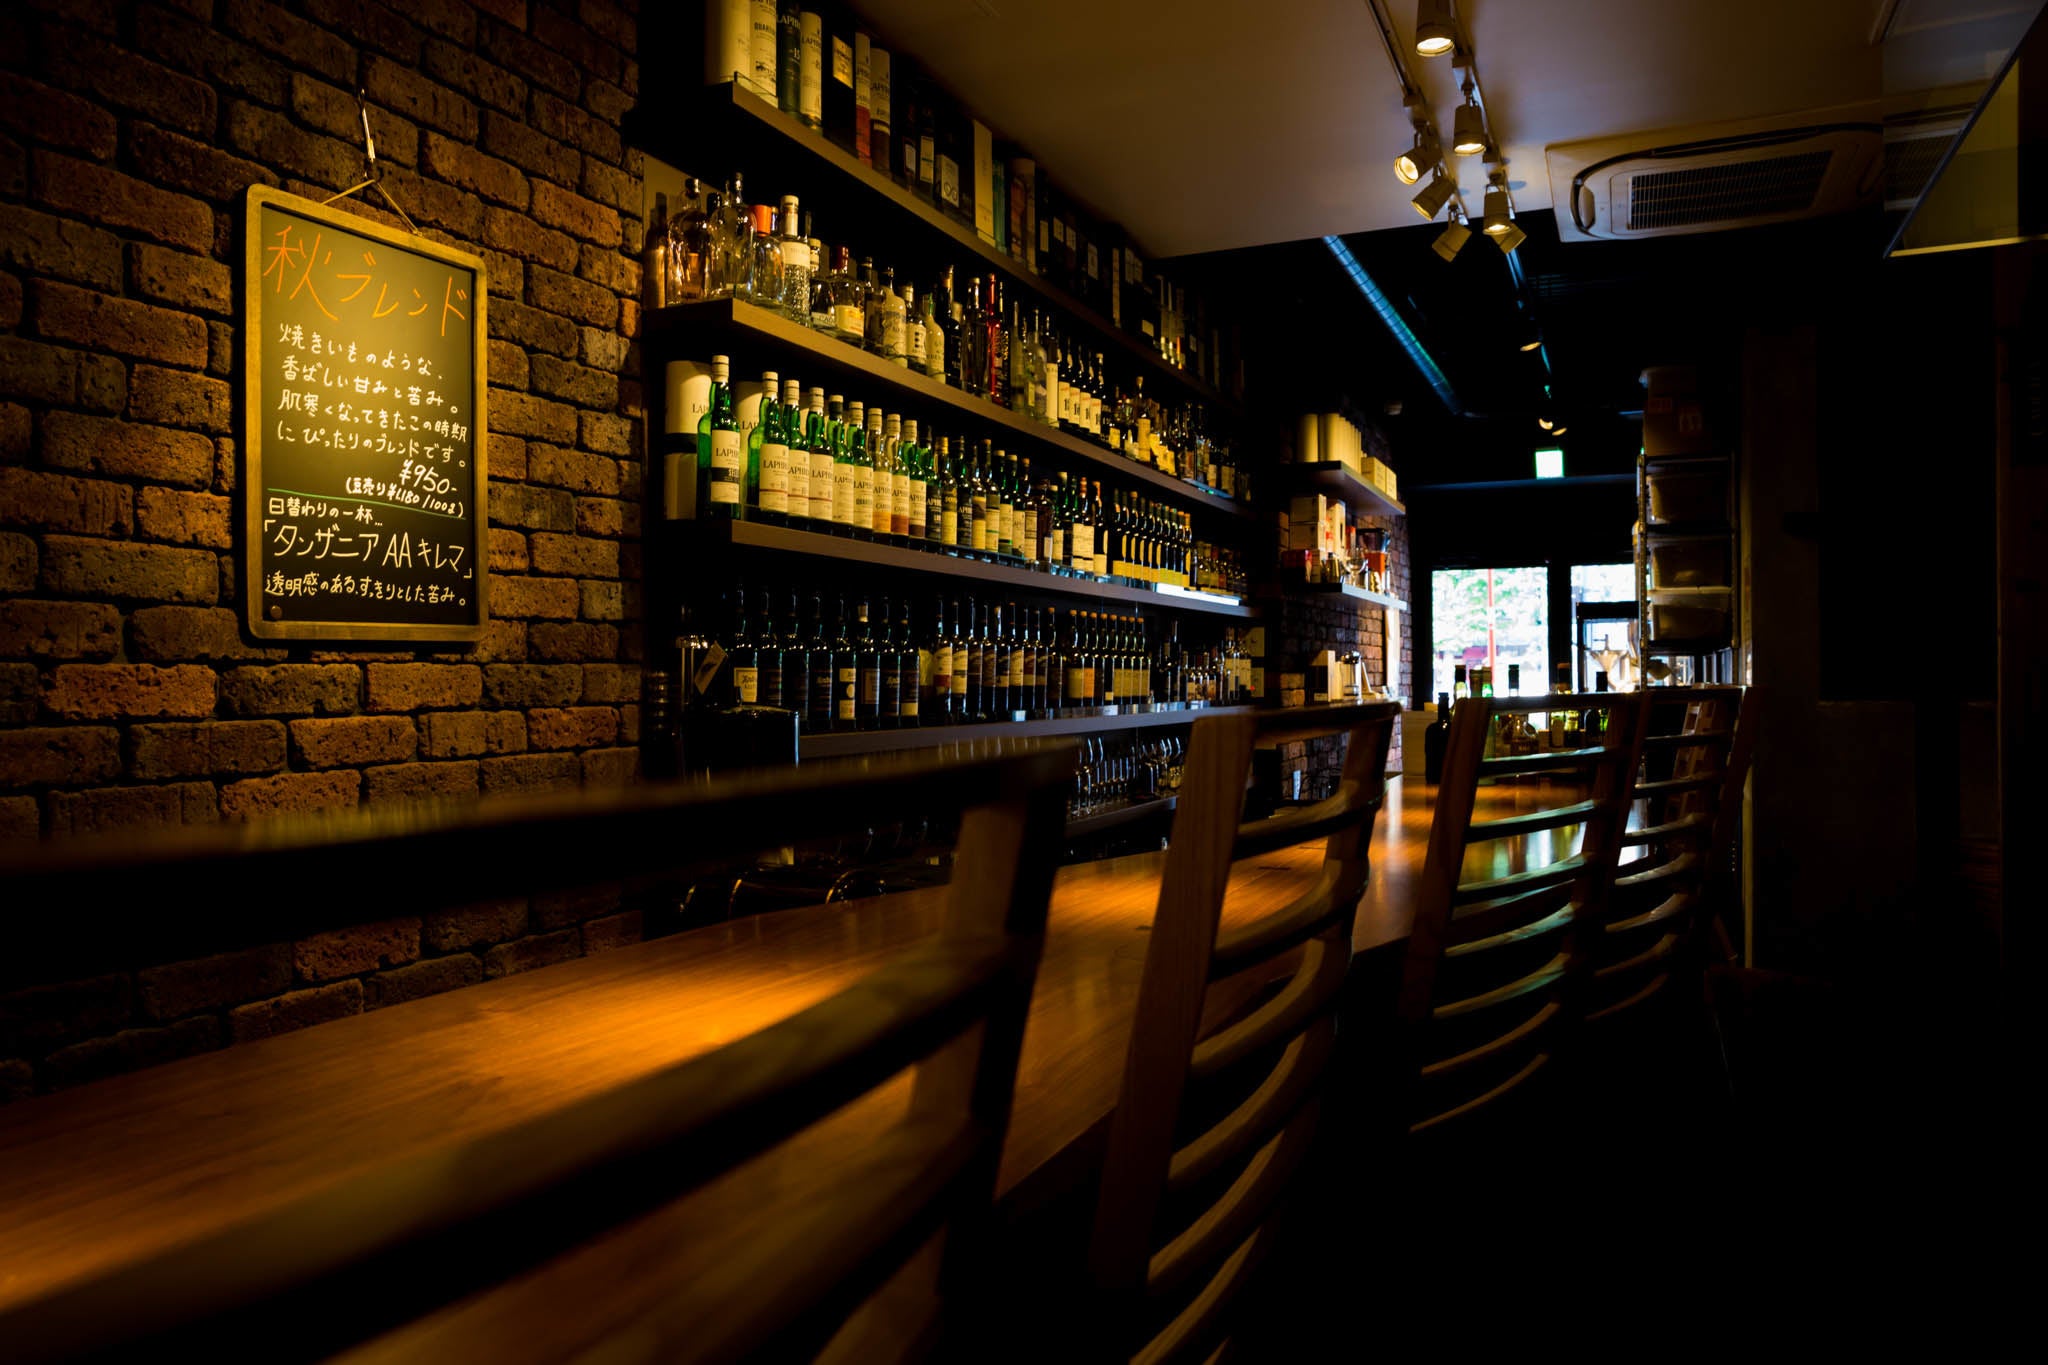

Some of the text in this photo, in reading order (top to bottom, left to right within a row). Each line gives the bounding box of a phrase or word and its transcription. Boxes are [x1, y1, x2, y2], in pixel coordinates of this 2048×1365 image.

[263, 225, 468, 337] 秋ブレンド
[279, 322, 442, 380] 焼きいものような、
[281, 354, 458, 414] 香ばしい甘みと苦み。
[277, 388, 467, 442] 肌寒くなってきたこの時期
[277, 420, 466, 468] にぴったりのブレンドです。
